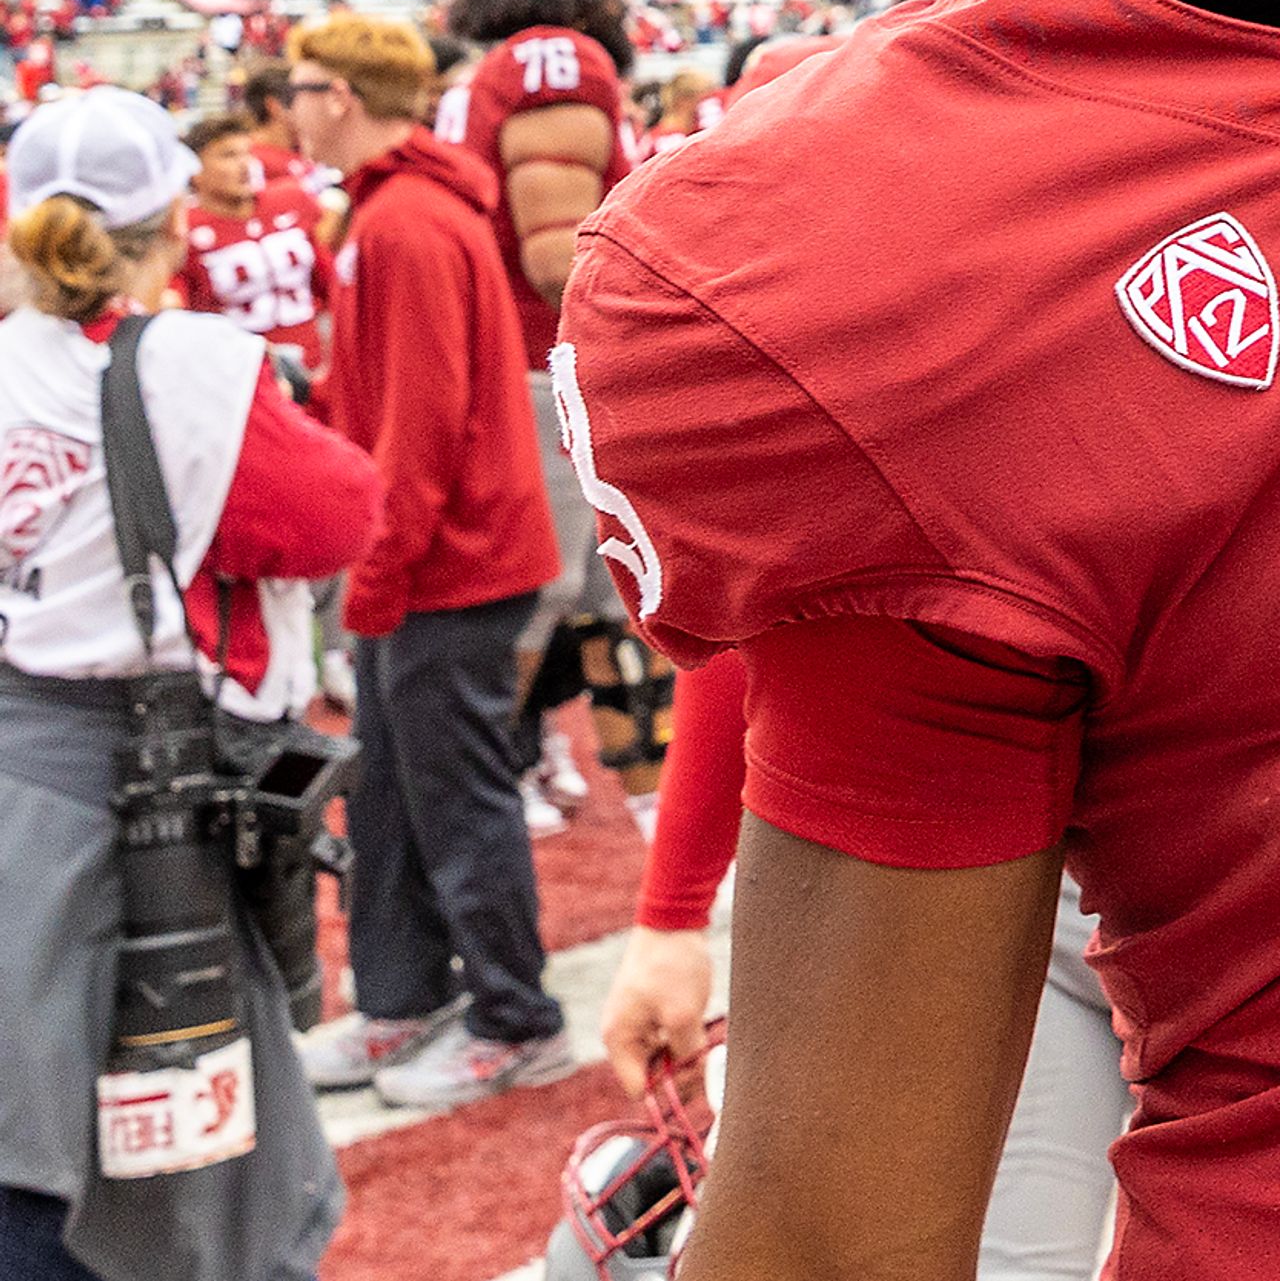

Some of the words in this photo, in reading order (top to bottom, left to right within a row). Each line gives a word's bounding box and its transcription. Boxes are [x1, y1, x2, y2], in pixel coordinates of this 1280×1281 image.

[513, 37, 580, 92] 76
[1127, 220, 1269, 355] PAC
[1187, 288, 1270, 367] 12
